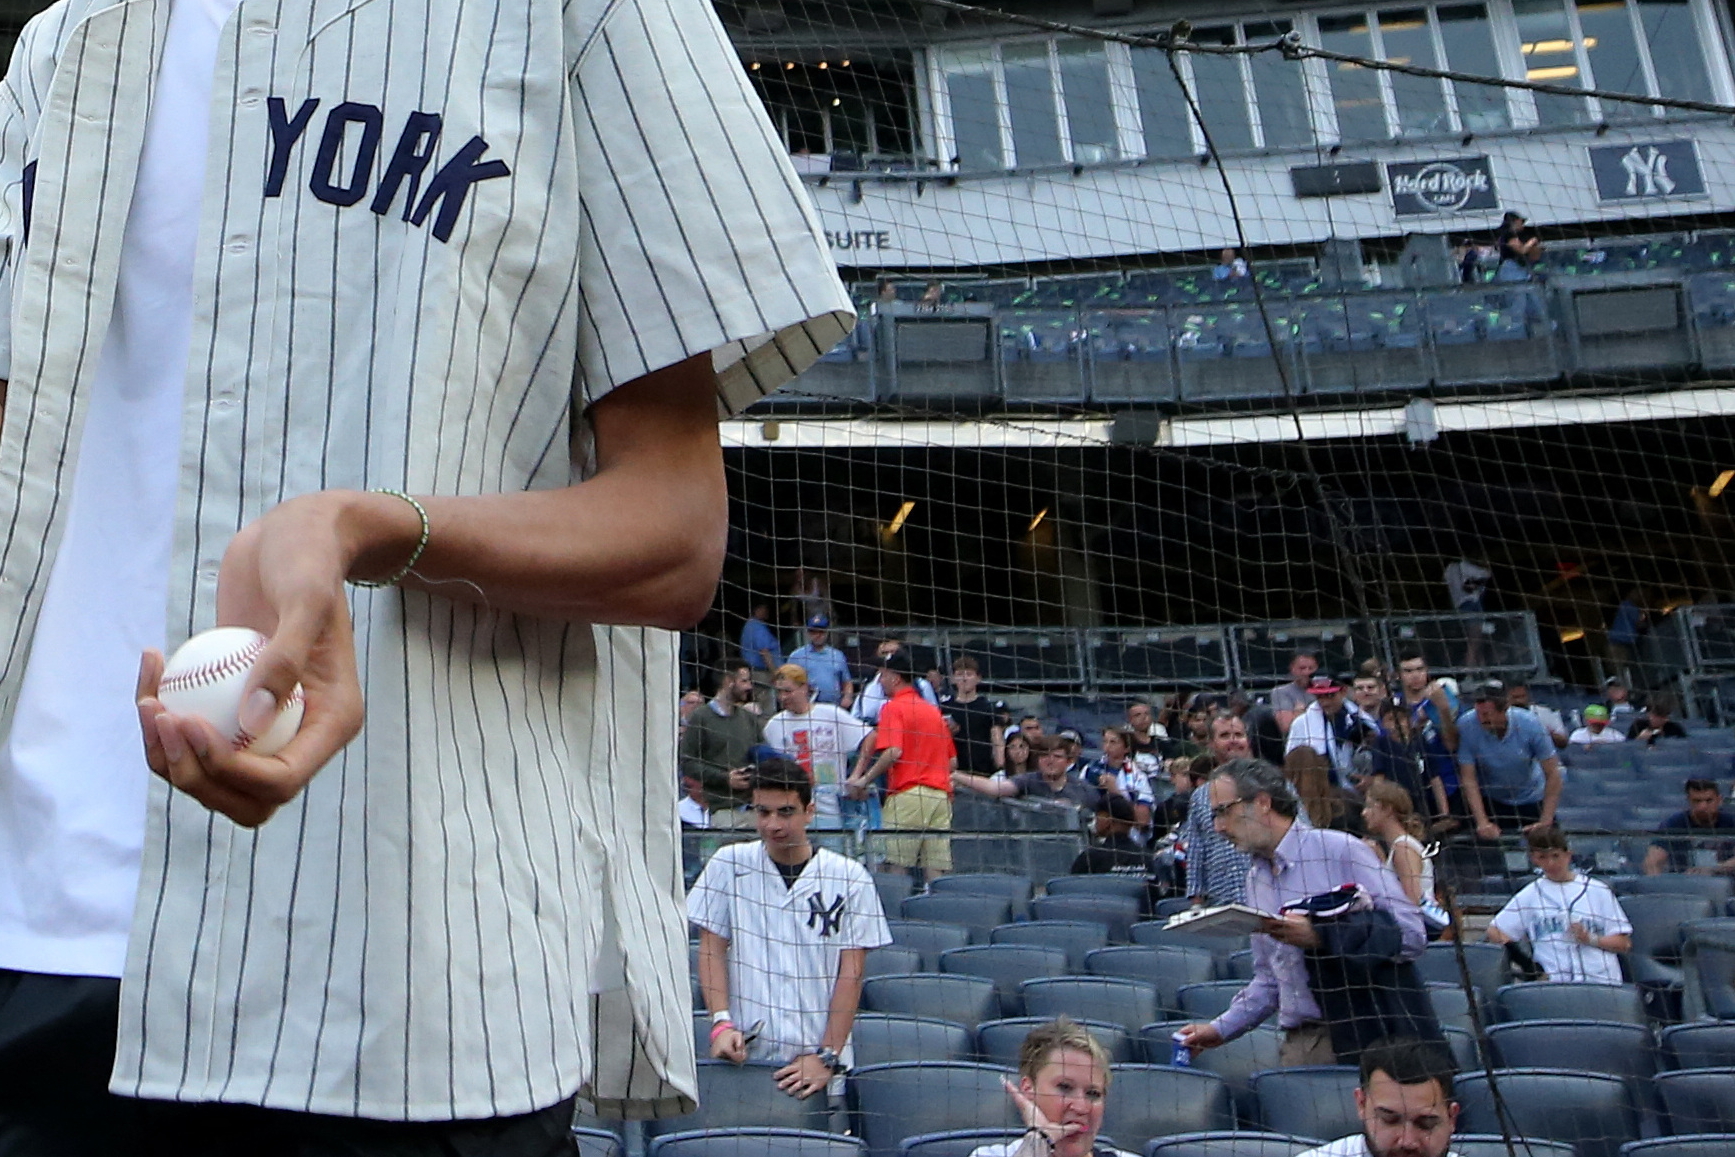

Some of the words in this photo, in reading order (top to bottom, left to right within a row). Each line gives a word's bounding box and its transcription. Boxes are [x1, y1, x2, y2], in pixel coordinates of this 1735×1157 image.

[265, 97, 511, 243] YORK
[1621, 146, 1676, 195] NY
[807, 891, 845, 937] NY
